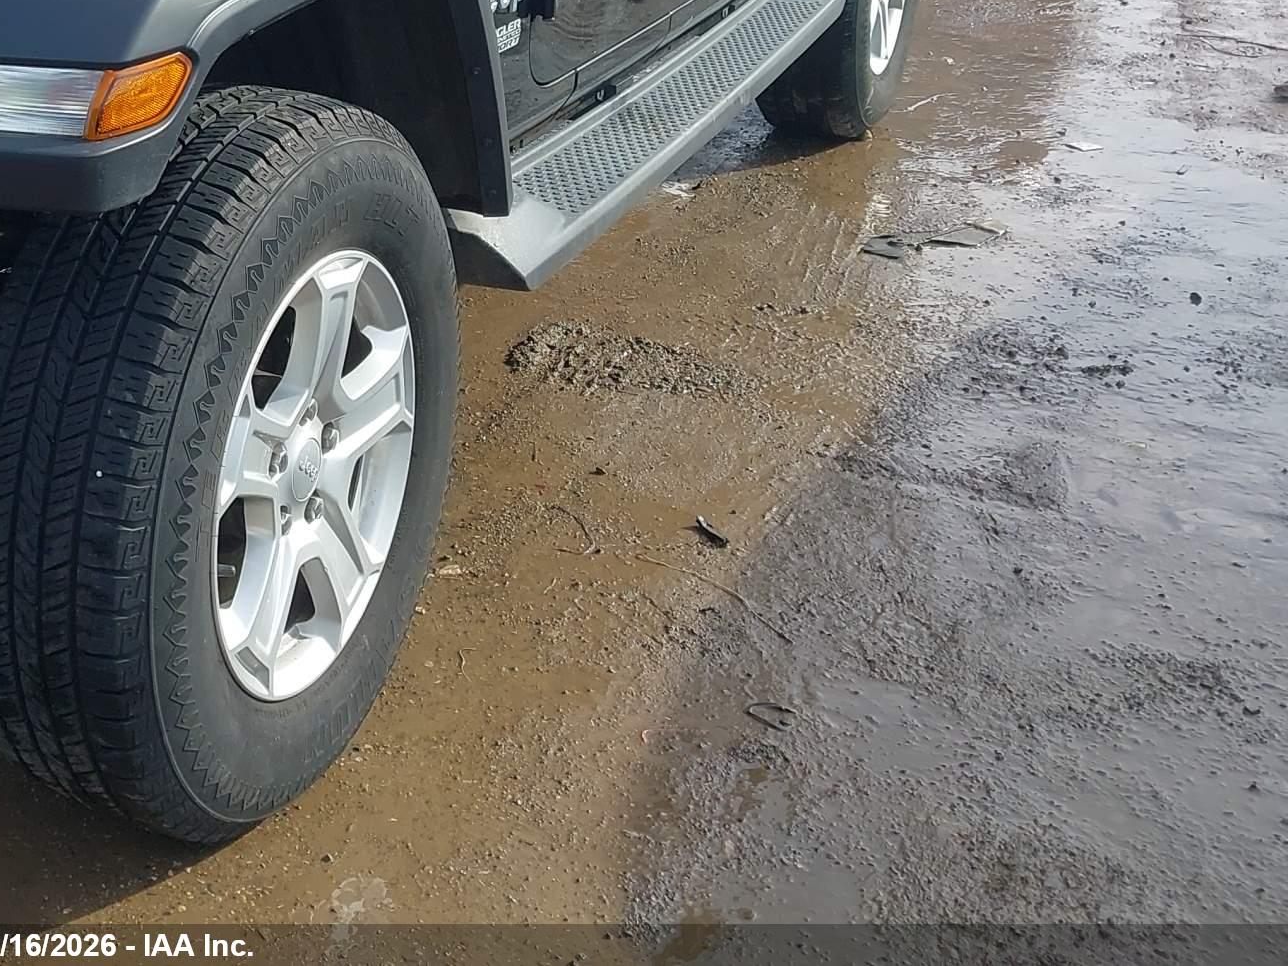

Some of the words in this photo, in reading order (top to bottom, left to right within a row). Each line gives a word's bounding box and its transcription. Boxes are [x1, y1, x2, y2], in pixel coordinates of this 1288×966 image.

[496, 18, 522, 37] GLER
[498, 37, 519, 53] ORT
[299, 455, 318, 482] Jeep
